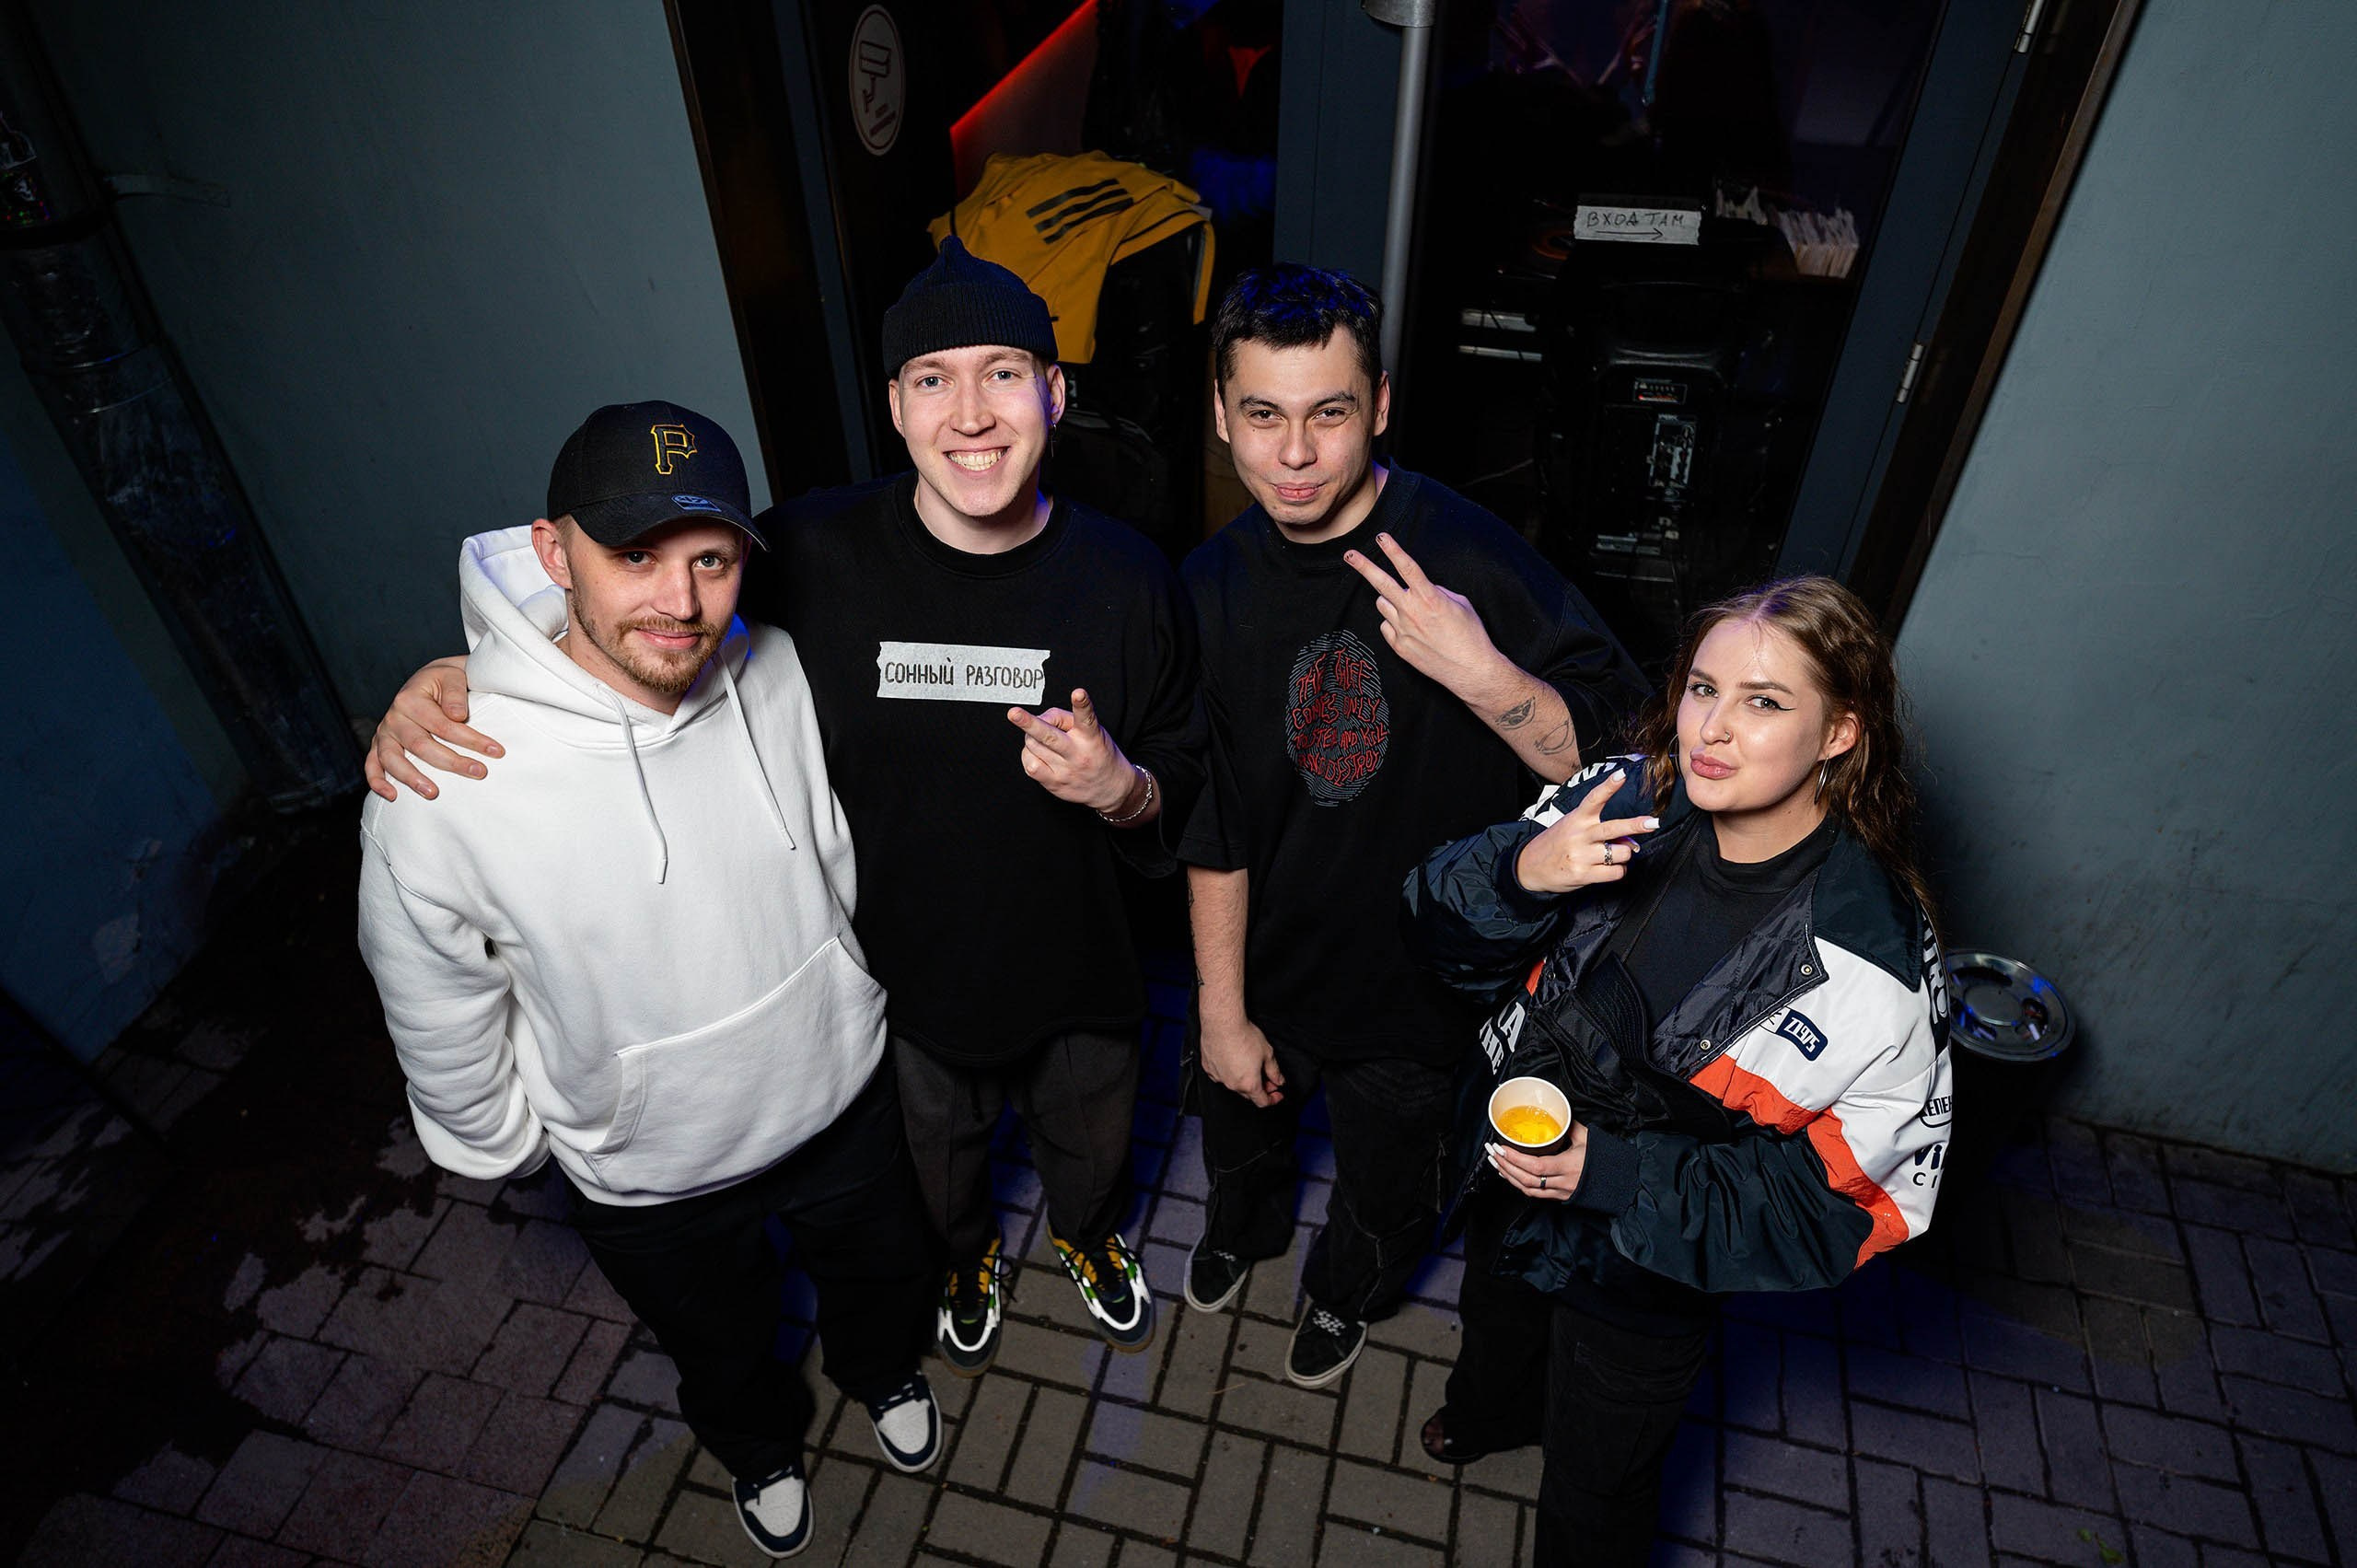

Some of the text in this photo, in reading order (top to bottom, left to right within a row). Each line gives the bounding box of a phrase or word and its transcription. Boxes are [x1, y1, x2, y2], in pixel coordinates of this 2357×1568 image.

[1644, 212, 1685, 227] ТАМ
[650, 423, 698, 475] P
[885, 656, 1045, 690] СОННЫЙ РАЗГОВОР
[1295, 646, 1373, 704] THE THIEF
[1292, 691, 1381, 729] COMES ONLY
[1341, 730, 1358, 749] AND
[1361, 722, 1388, 747] KILL
[1324, 749, 1380, 787] DESTROY
